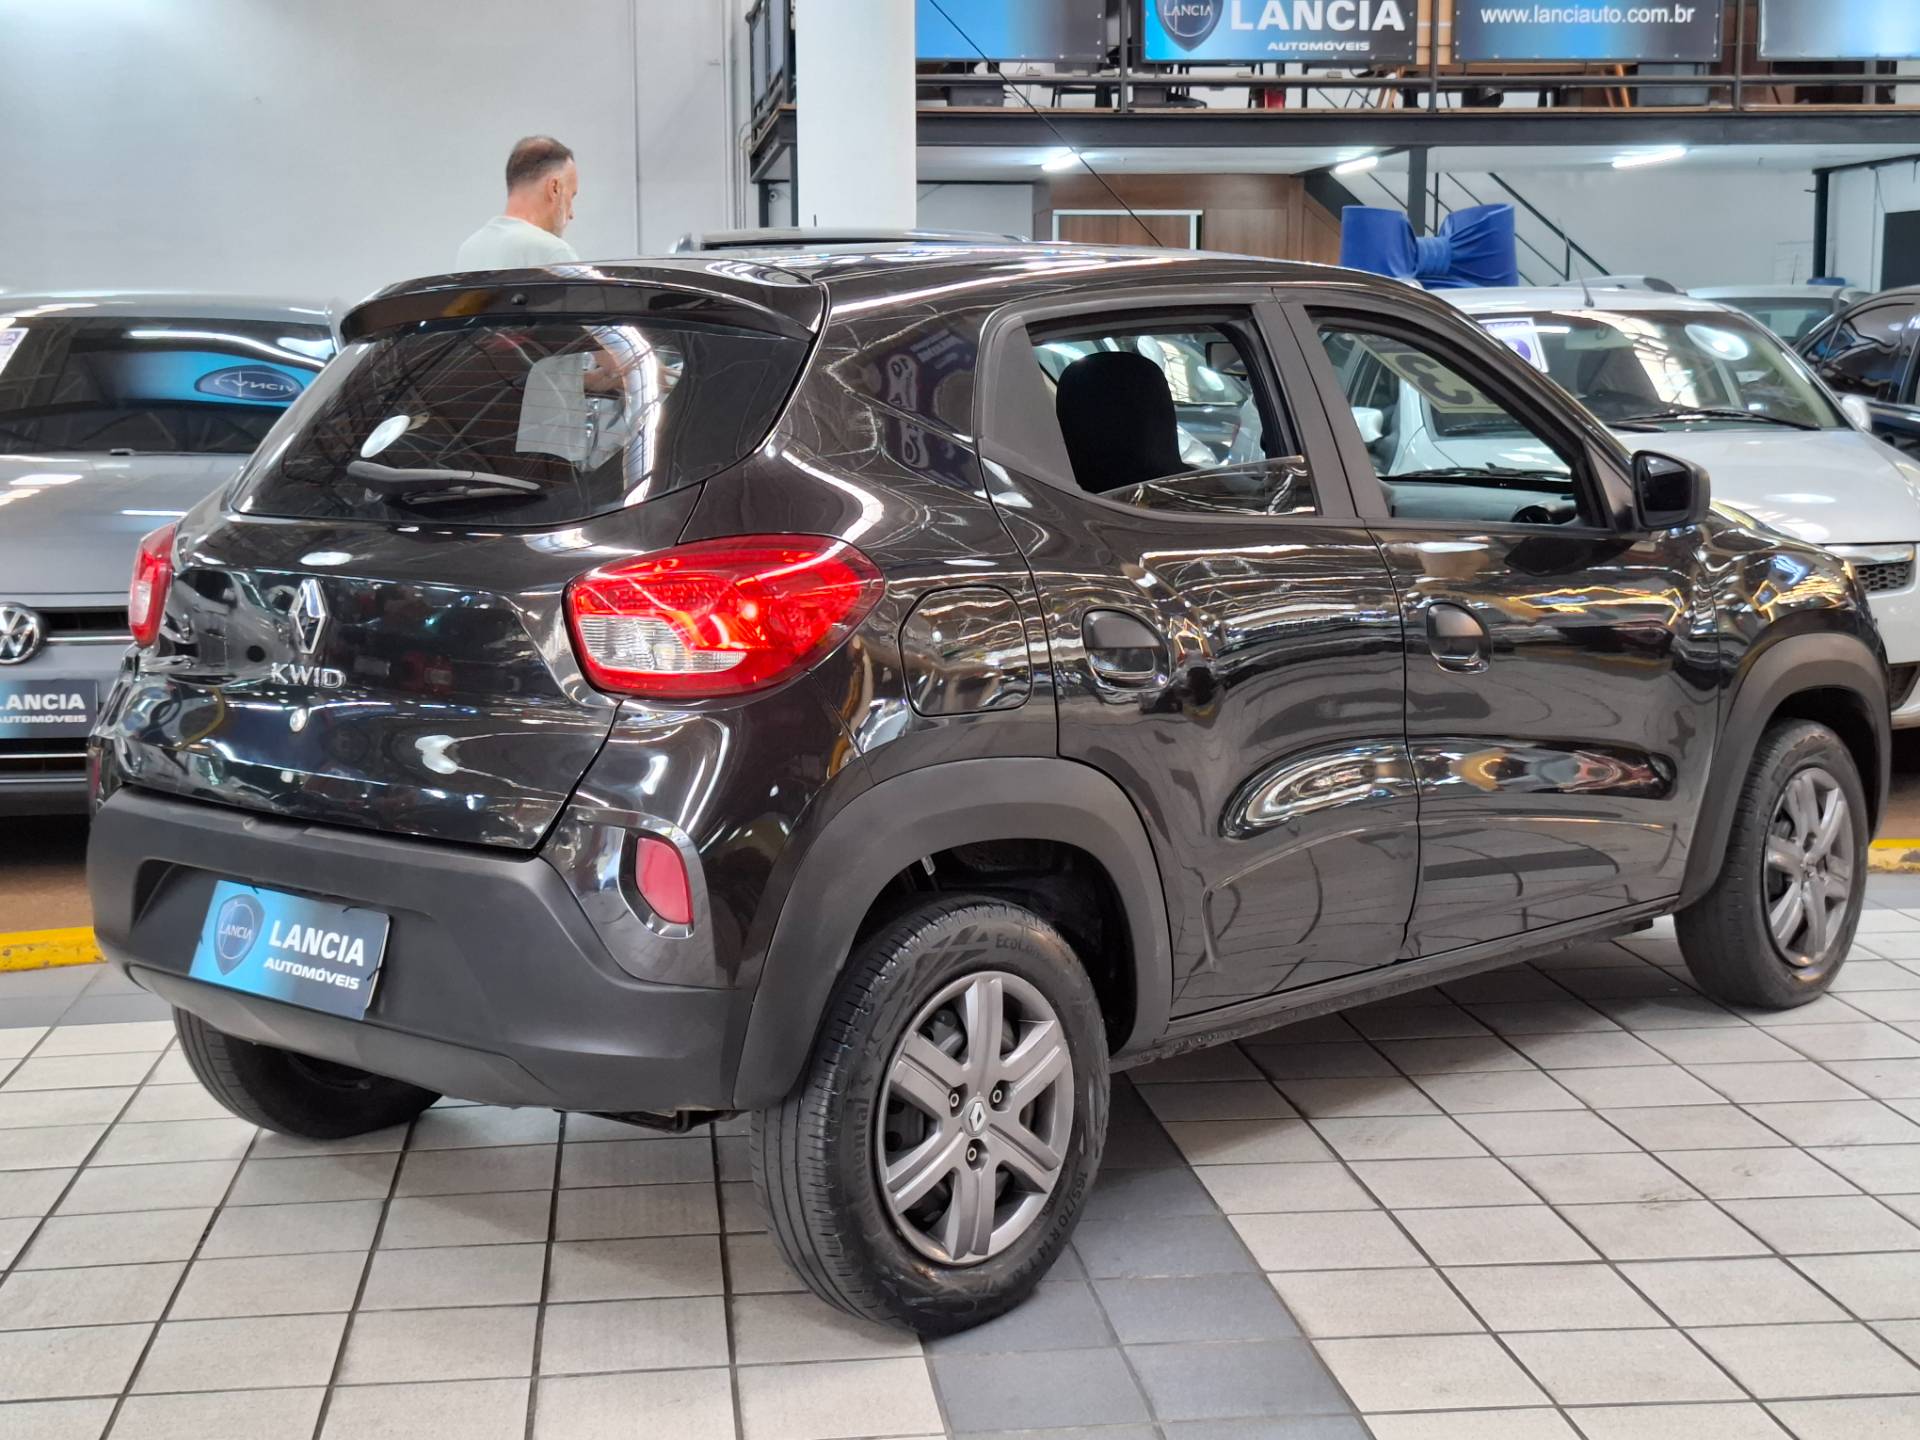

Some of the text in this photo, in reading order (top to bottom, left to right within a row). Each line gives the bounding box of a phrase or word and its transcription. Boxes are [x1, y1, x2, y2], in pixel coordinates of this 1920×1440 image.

[1163, 4, 1213, 17] LANCIA
[1230, 0, 1406, 31] LANCIA
[1480, 4, 1696, 24] www.lanciauto.com.br
[1266, 41, 1370, 51] AUTOMÓVEIS
[271, 662, 347, 689] KWID
[0, 693, 86, 711] ANCIA
[0, 714, 87, 724] UTOMÓVEIS
[218, 920, 253, 940] LANCIA
[268, 920, 365, 967] LANCIA
[263, 956, 361, 990] AUTOMÓVEIS
